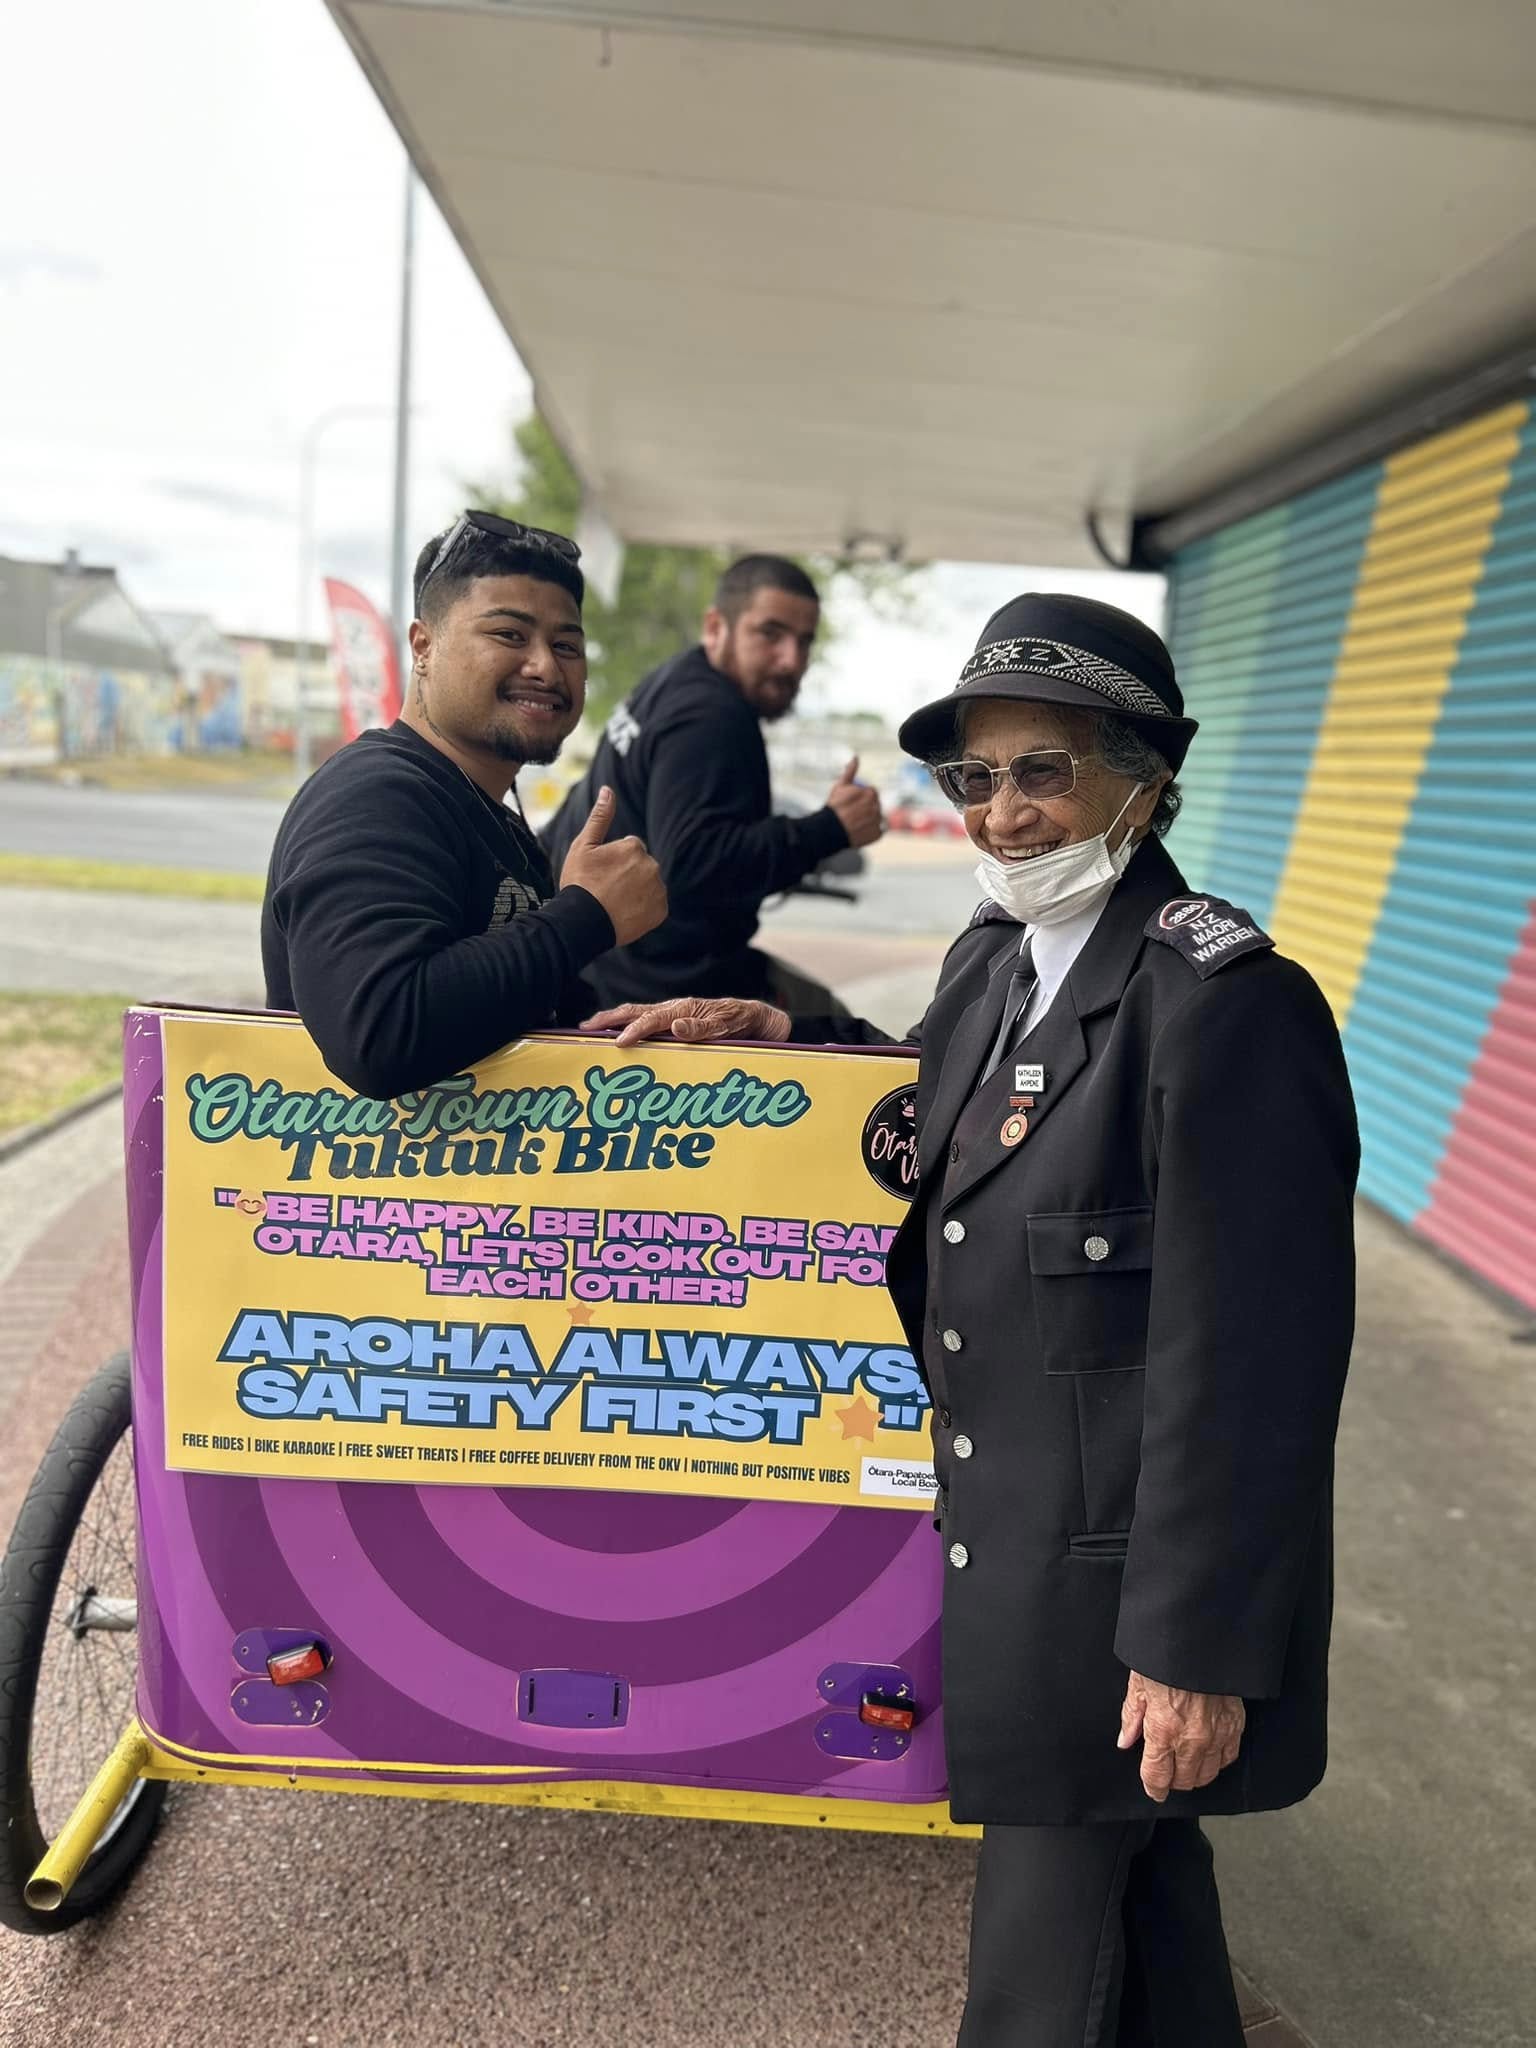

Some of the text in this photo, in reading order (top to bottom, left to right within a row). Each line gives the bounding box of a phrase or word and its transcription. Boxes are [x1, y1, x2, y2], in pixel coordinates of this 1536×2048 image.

[1191, 918, 1239, 946] MAORI
[1192, 926, 1259, 962] WARDEN
[187, 1066, 811, 1141] Otara Town Centre
[281, 1122, 715, 1180] Tuktuk Bike
[338, 1196, 525, 1235] HAPPY.
[531, 1208, 599, 1239] BE
[605, 1210, 735, 1244] KIND.
[741, 1216, 809, 1247] BE
[813, 1221, 900, 1253] SAF
[254, 1227, 888, 1286] OTARA, LET'S LOOK OUT FO
[427, 1267, 748, 1307] EACH OTHER!
[217, 1308, 546, 1375] AROHA
[238, 1365, 581, 1431] SAFETY
[581, 1382, 821, 1444] FIRST
[183, 1433, 208, 1448] FREE
[212, 1436, 244, 1451] RIDES
[255, 1438, 280, 1453] BIKE
[283, 1440, 335, 1456] KARAOKE
[346, 1443, 373, 1458] FREE
[376, 1444, 415, 1460] SWEET
[417, 1446, 458, 1462] TREATS
[469, 1449, 496, 1463] FREE
[500, 1450, 540, 1465] COFFEE
[543, 1451, 596, 1467] DELIVERY
[599, 1453, 631, 1469] FROM
[635, 1455, 655, 1470] THE
[658, 1457, 681, 1471] OKV
[691, 1459, 738, 1476] NOTHING
[742, 1463, 763, 1478] BUT
[766, 1465, 815, 1482] POSITIVE
[818, 1468, 851, 1484] VIBES
[891, 1477, 917, 1487] Local
